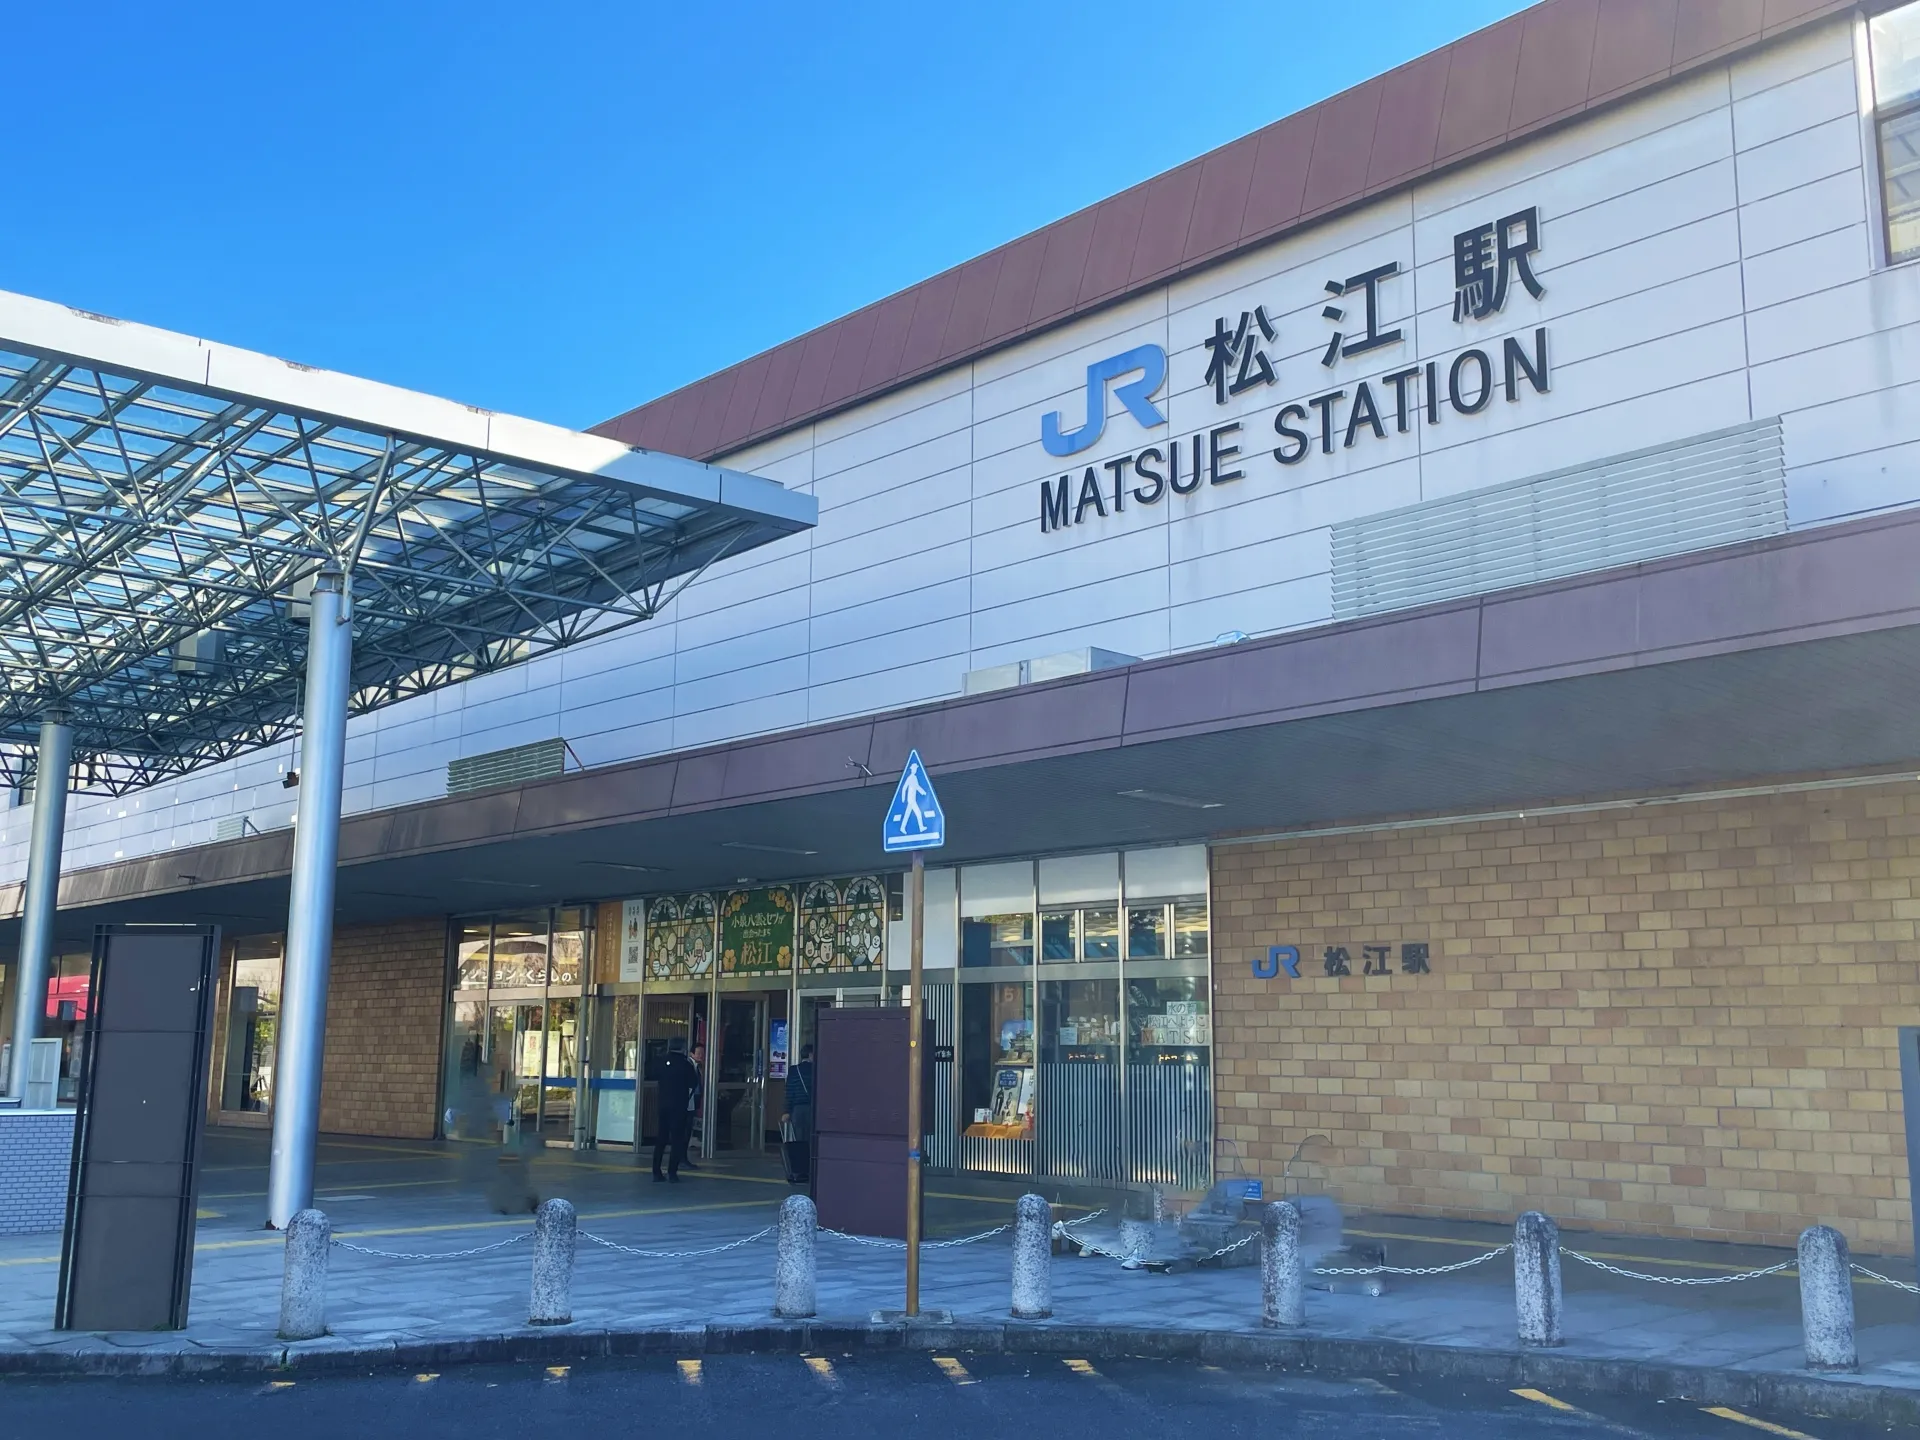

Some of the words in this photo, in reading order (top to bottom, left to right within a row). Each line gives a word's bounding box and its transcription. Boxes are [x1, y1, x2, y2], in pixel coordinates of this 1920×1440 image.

[1041, 343, 1168, 458] JR
[1204, 205, 1548, 406] 松江駅
[1040, 421, 1246, 534] MATSUE
[1273, 327, 1551, 466] STATION
[740, 941, 773, 966] 松江
[1251, 944, 1302, 979] JR
[1323, 943, 1431, 977] 松江駅
